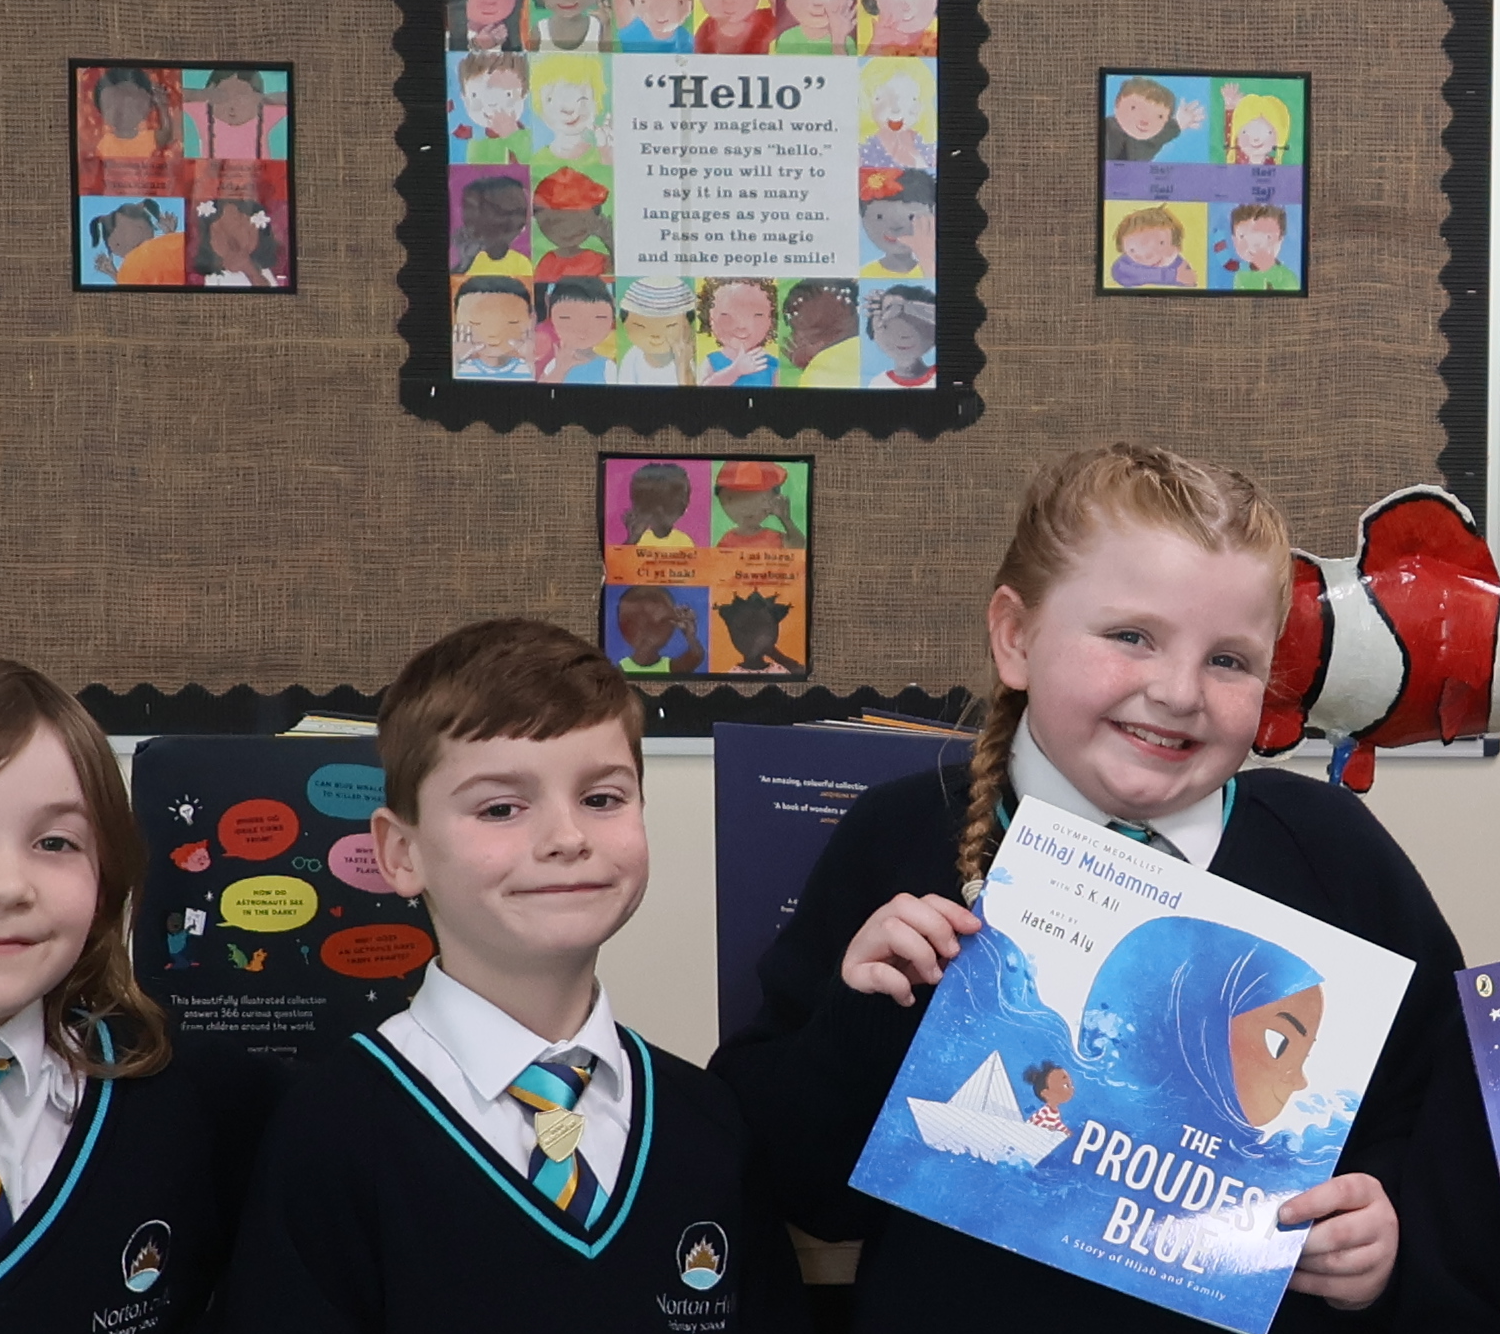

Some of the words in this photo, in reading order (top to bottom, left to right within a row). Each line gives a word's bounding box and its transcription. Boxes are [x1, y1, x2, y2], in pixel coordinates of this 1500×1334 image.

[644, 74, 825, 110] “Hello”
[632, 118, 647, 130] is
[653, 121, 663, 130] a
[669, 120, 707, 135] very
[714, 119, 783, 134] magical
[790, 120, 838, 131] word.
[640, 143, 718, 157] Everyone
[724, 146, 762, 158] says
[646, 165, 654, 176] I
[660, 165, 697, 180] hope
[704, 167, 733, 180] you
[740, 165, 772, 177] will
[778, 166, 803, 180] try
[809, 167, 825, 178] to
[663, 188, 691, 201] say
[697, 186, 710, 198] it
[717, 186, 732, 198] in
[739, 188, 757, 198] as
[764, 189, 809, 201] many
[643, 208, 730, 223] languages
[736, 210, 754, 220] as
[760, 211, 790, 223] you
[796, 211, 829, 221] can.
[660, 229, 698, 241] Pass
[704, 232, 724, 241] on
[730, 229, 757, 241] the
[763, 230, 813, 244] magic
[638, 251, 667, 262] and
[674, 251, 718, 263] make
[724, 252, 778, 266] people
[784, 252, 835, 264] smile!
[1052, 823, 1100, 849] OLYMPIC
[1103, 844, 1164, 875] MEDALLIST
[1049, 878, 1071, 892] WITH
[1078, 851, 1182, 910] Muhammad
[1020, 910, 1066, 940] Hatem
[1070, 931, 1095, 954] Aly
[1180, 1124, 1222, 1159] THE
[1102, 1196, 1219, 1275] BLUE
[1061, 1234, 1070, 1244] A
[1073, 1238, 1105, 1260] Story
[1108, 1252, 1123, 1265] of
[1124, 1257, 1157, 1278] Hijab
[1160, 1270, 1184, 1285] and
[1187, 1279, 1227, 1302] Family
